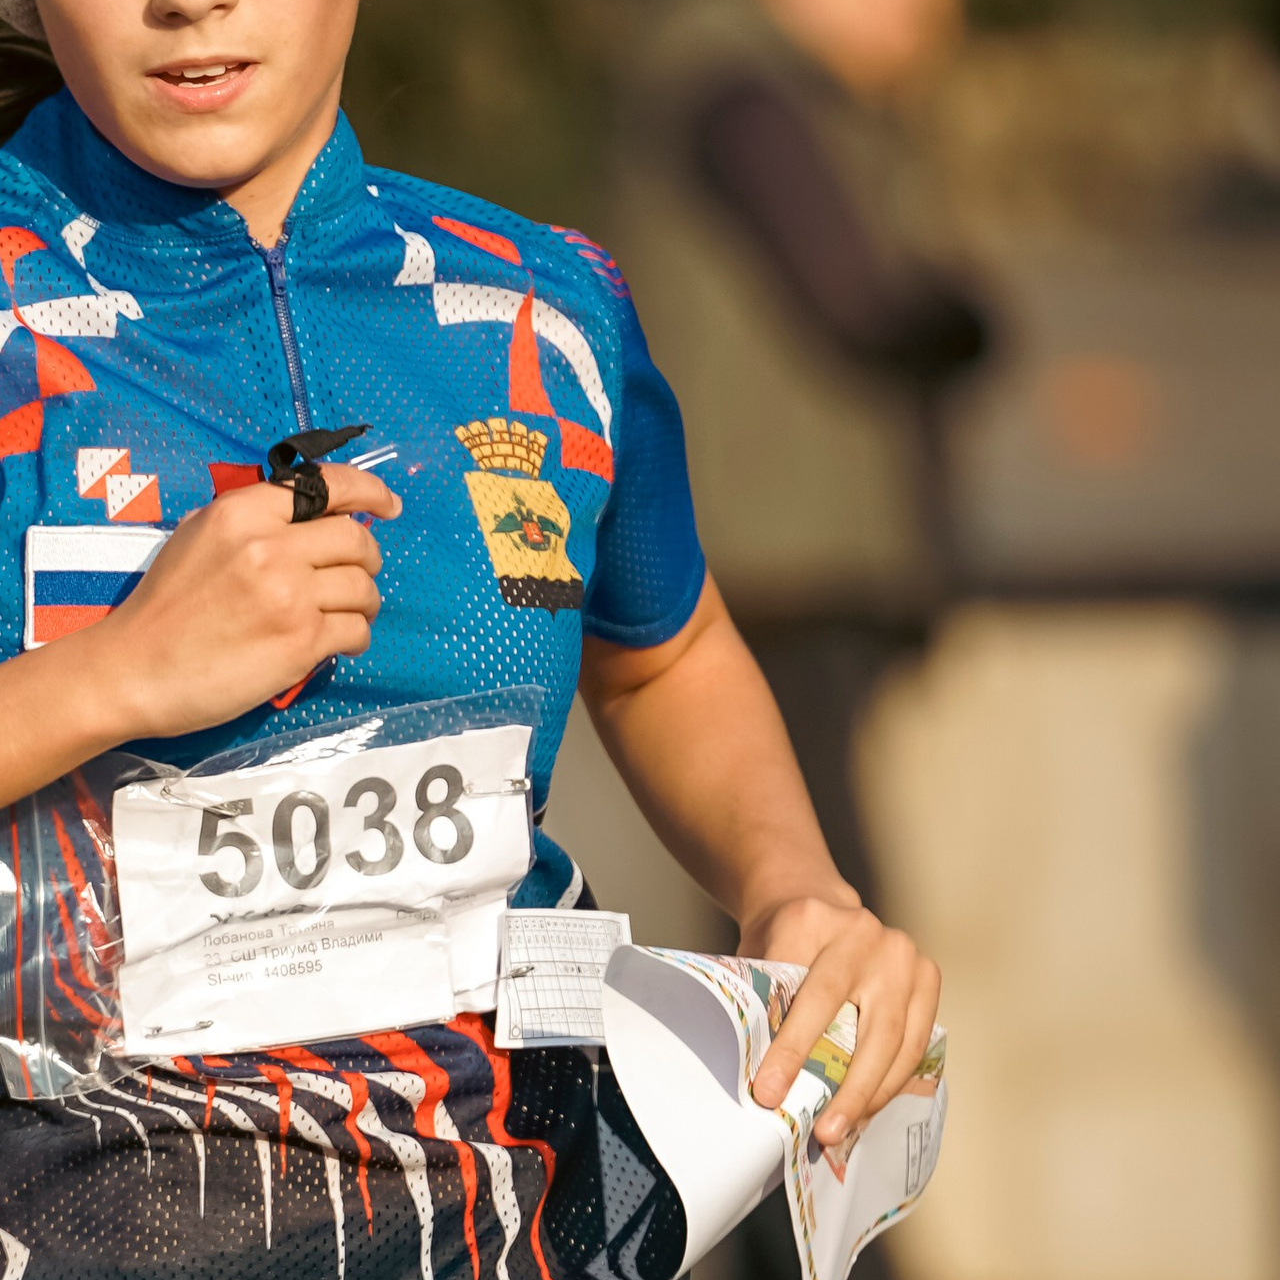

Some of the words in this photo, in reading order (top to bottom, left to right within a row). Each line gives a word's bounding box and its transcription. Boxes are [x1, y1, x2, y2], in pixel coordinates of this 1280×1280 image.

[197, 763, 474, 898] 5038
[202, 927, 275, 948] Лобанова
[278, 919, 336, 937] Таяна
[262, 940, 318, 960] Триумф
[321, 930, 384, 951] Владими
[263, 959, 323, 979] 4408595
